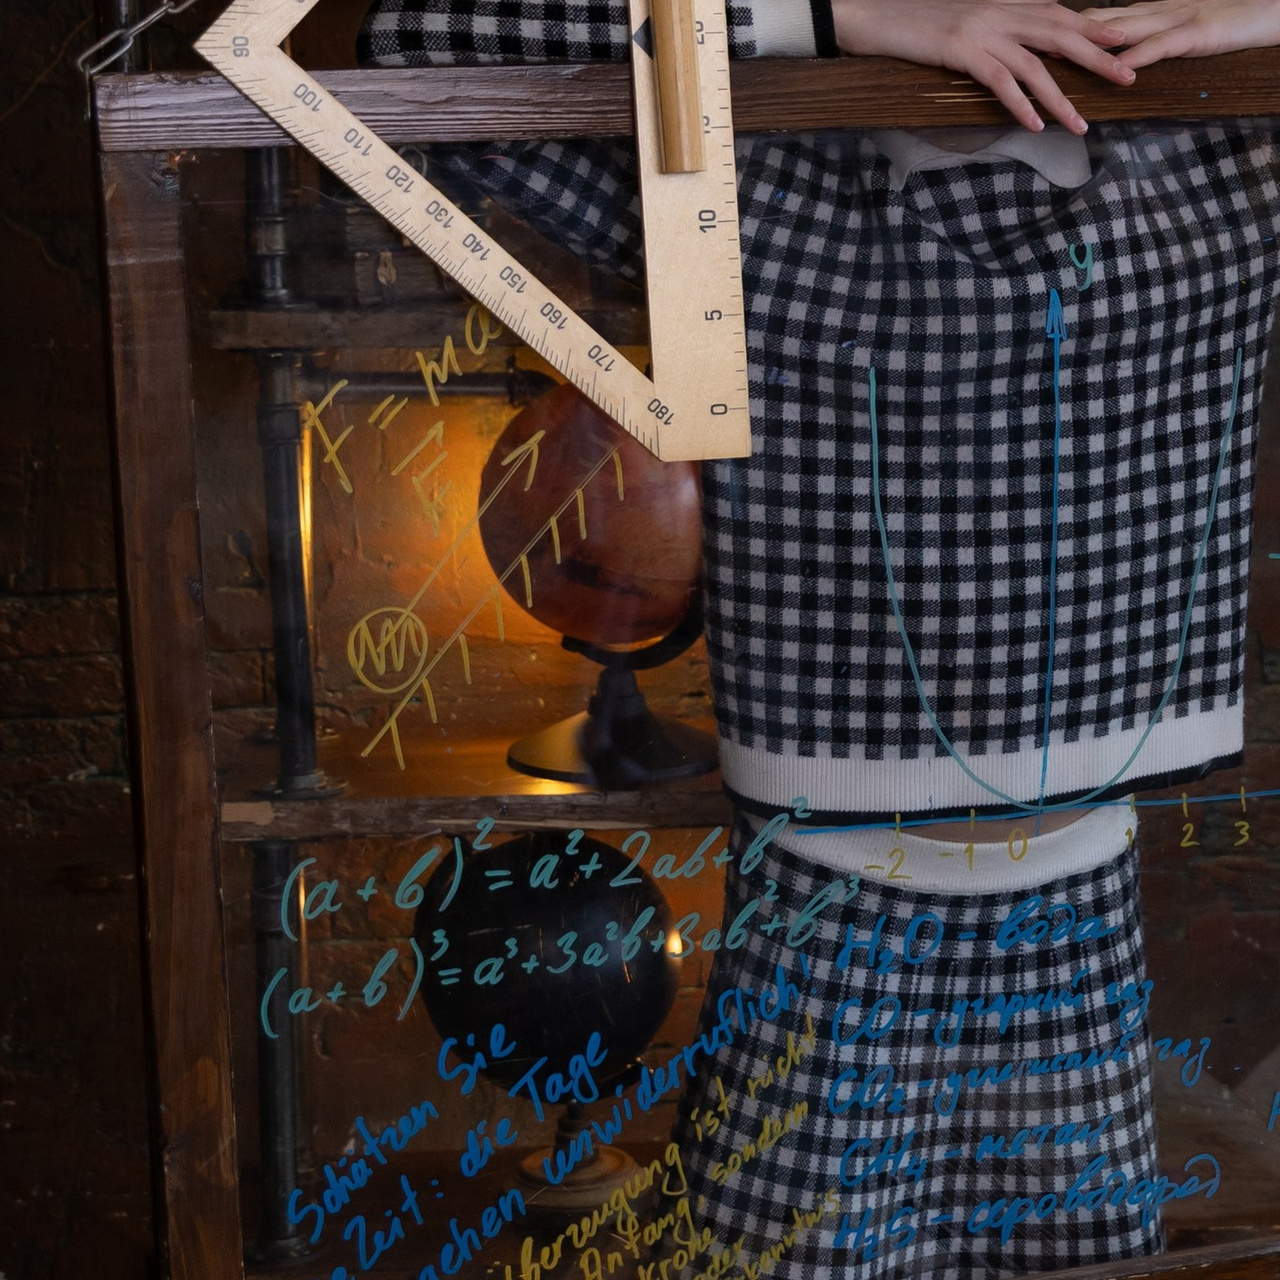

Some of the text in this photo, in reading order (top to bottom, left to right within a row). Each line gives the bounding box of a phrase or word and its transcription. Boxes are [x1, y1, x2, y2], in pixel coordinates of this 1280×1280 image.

[232, 36, 249, 57] 90
[293, 83, 324, 112] 100
[344, 127, 374, 157] 110
[385, 165, 416, 193] 120
[425, 200, 455, 229] 130
[699, 209, 718, 234] 10
[462, 232, 492, 261] 140
[499, 265, 528, 294] 150
[540, 302, 569, 330] 160
[704, 309, 723, 322] 5
[586, 344, 616, 373] 170
[647, 397, 676, 427] 180
[710, 403, 728, 416] 0
[1180, 823, 1199, 848] 2
[1234, 821, 1251, 847] 3
[438, 1023, 517, 1095] Sie
[460, 1116, 518, 1179] die
[508, 1031, 609, 1121] Tage
